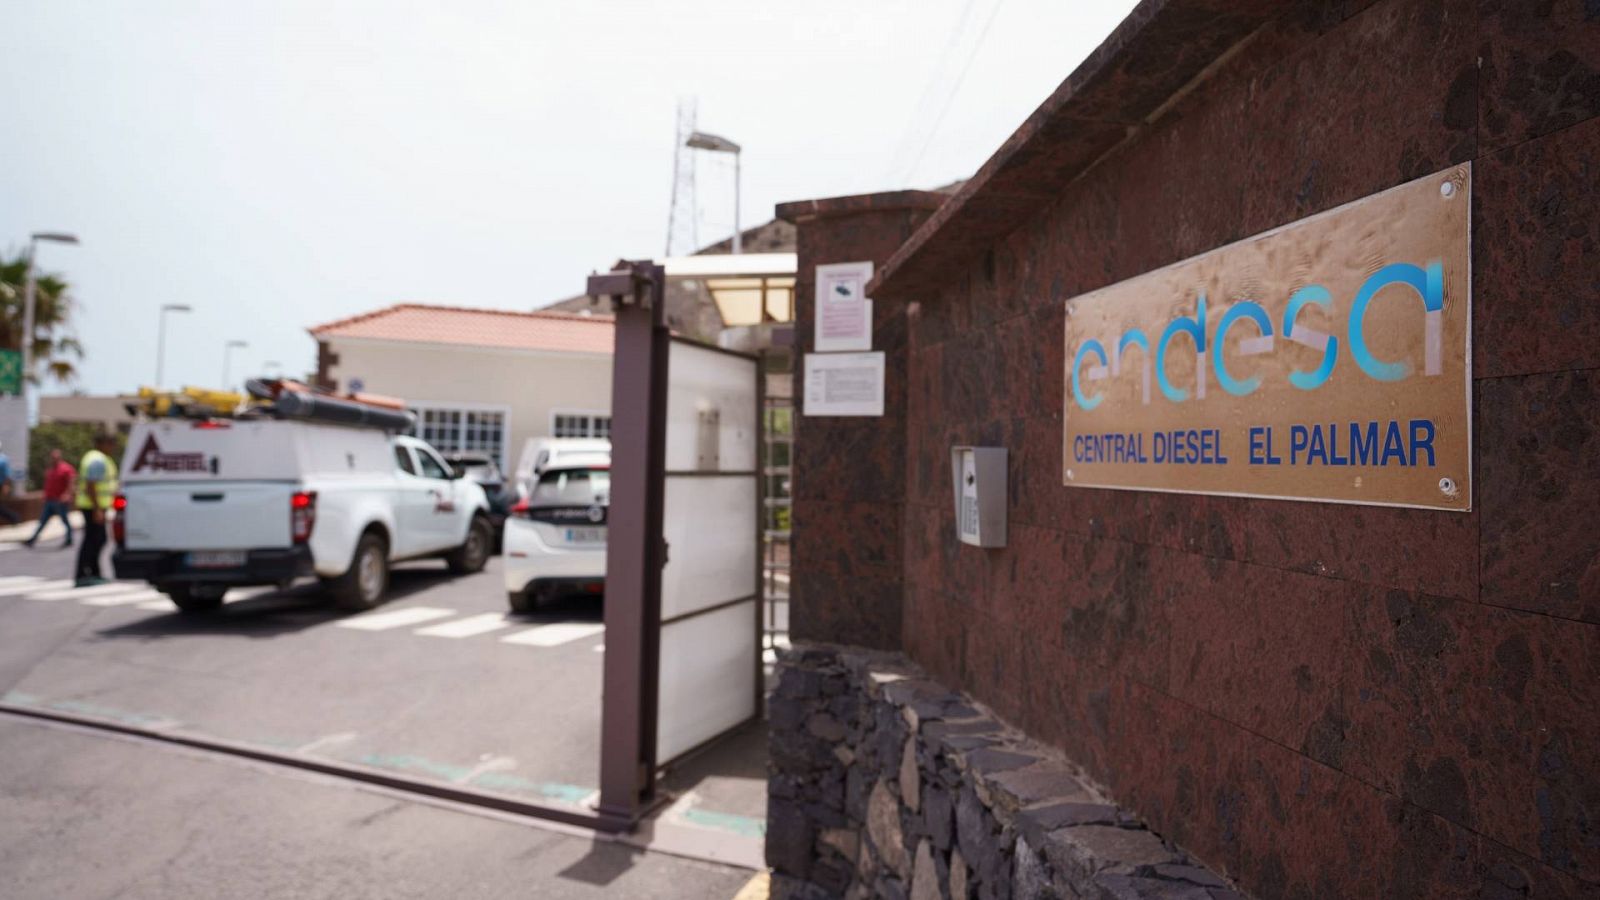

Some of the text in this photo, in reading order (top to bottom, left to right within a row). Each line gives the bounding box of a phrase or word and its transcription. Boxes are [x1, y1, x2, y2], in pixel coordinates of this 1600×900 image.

[1071, 260, 1443, 411] endesa
[1073, 419, 1436, 466] CENTRAL DIESEL EL PALMAR
